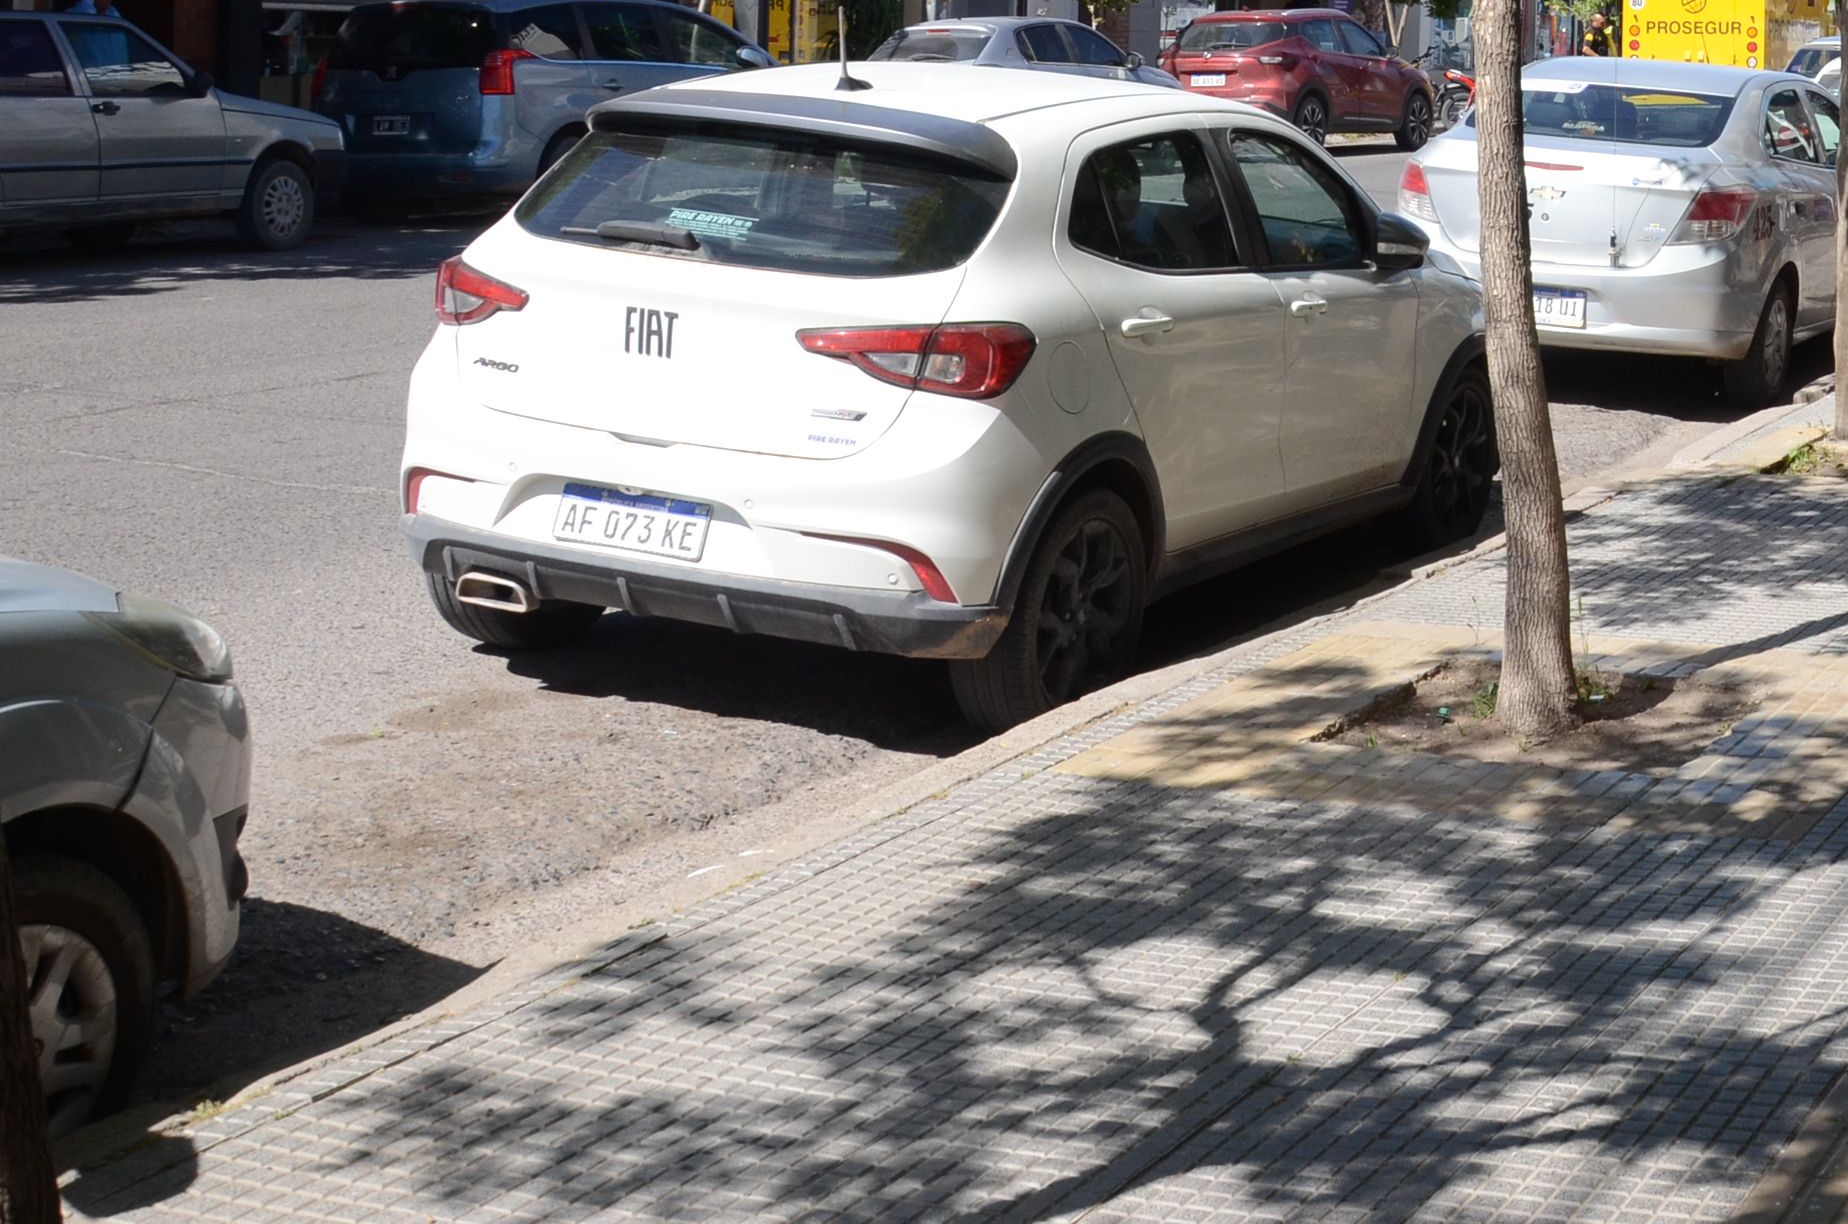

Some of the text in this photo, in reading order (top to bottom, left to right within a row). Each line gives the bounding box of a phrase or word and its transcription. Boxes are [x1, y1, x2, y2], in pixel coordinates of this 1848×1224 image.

[1646, 21, 1742, 35] PROSEGUR
[1535, 296, 1553, 314] 18
[624, 306, 679, 359] FIAT
[473, 357, 519, 373] ARGO
[560, 503, 698, 552] AF 073 KE
